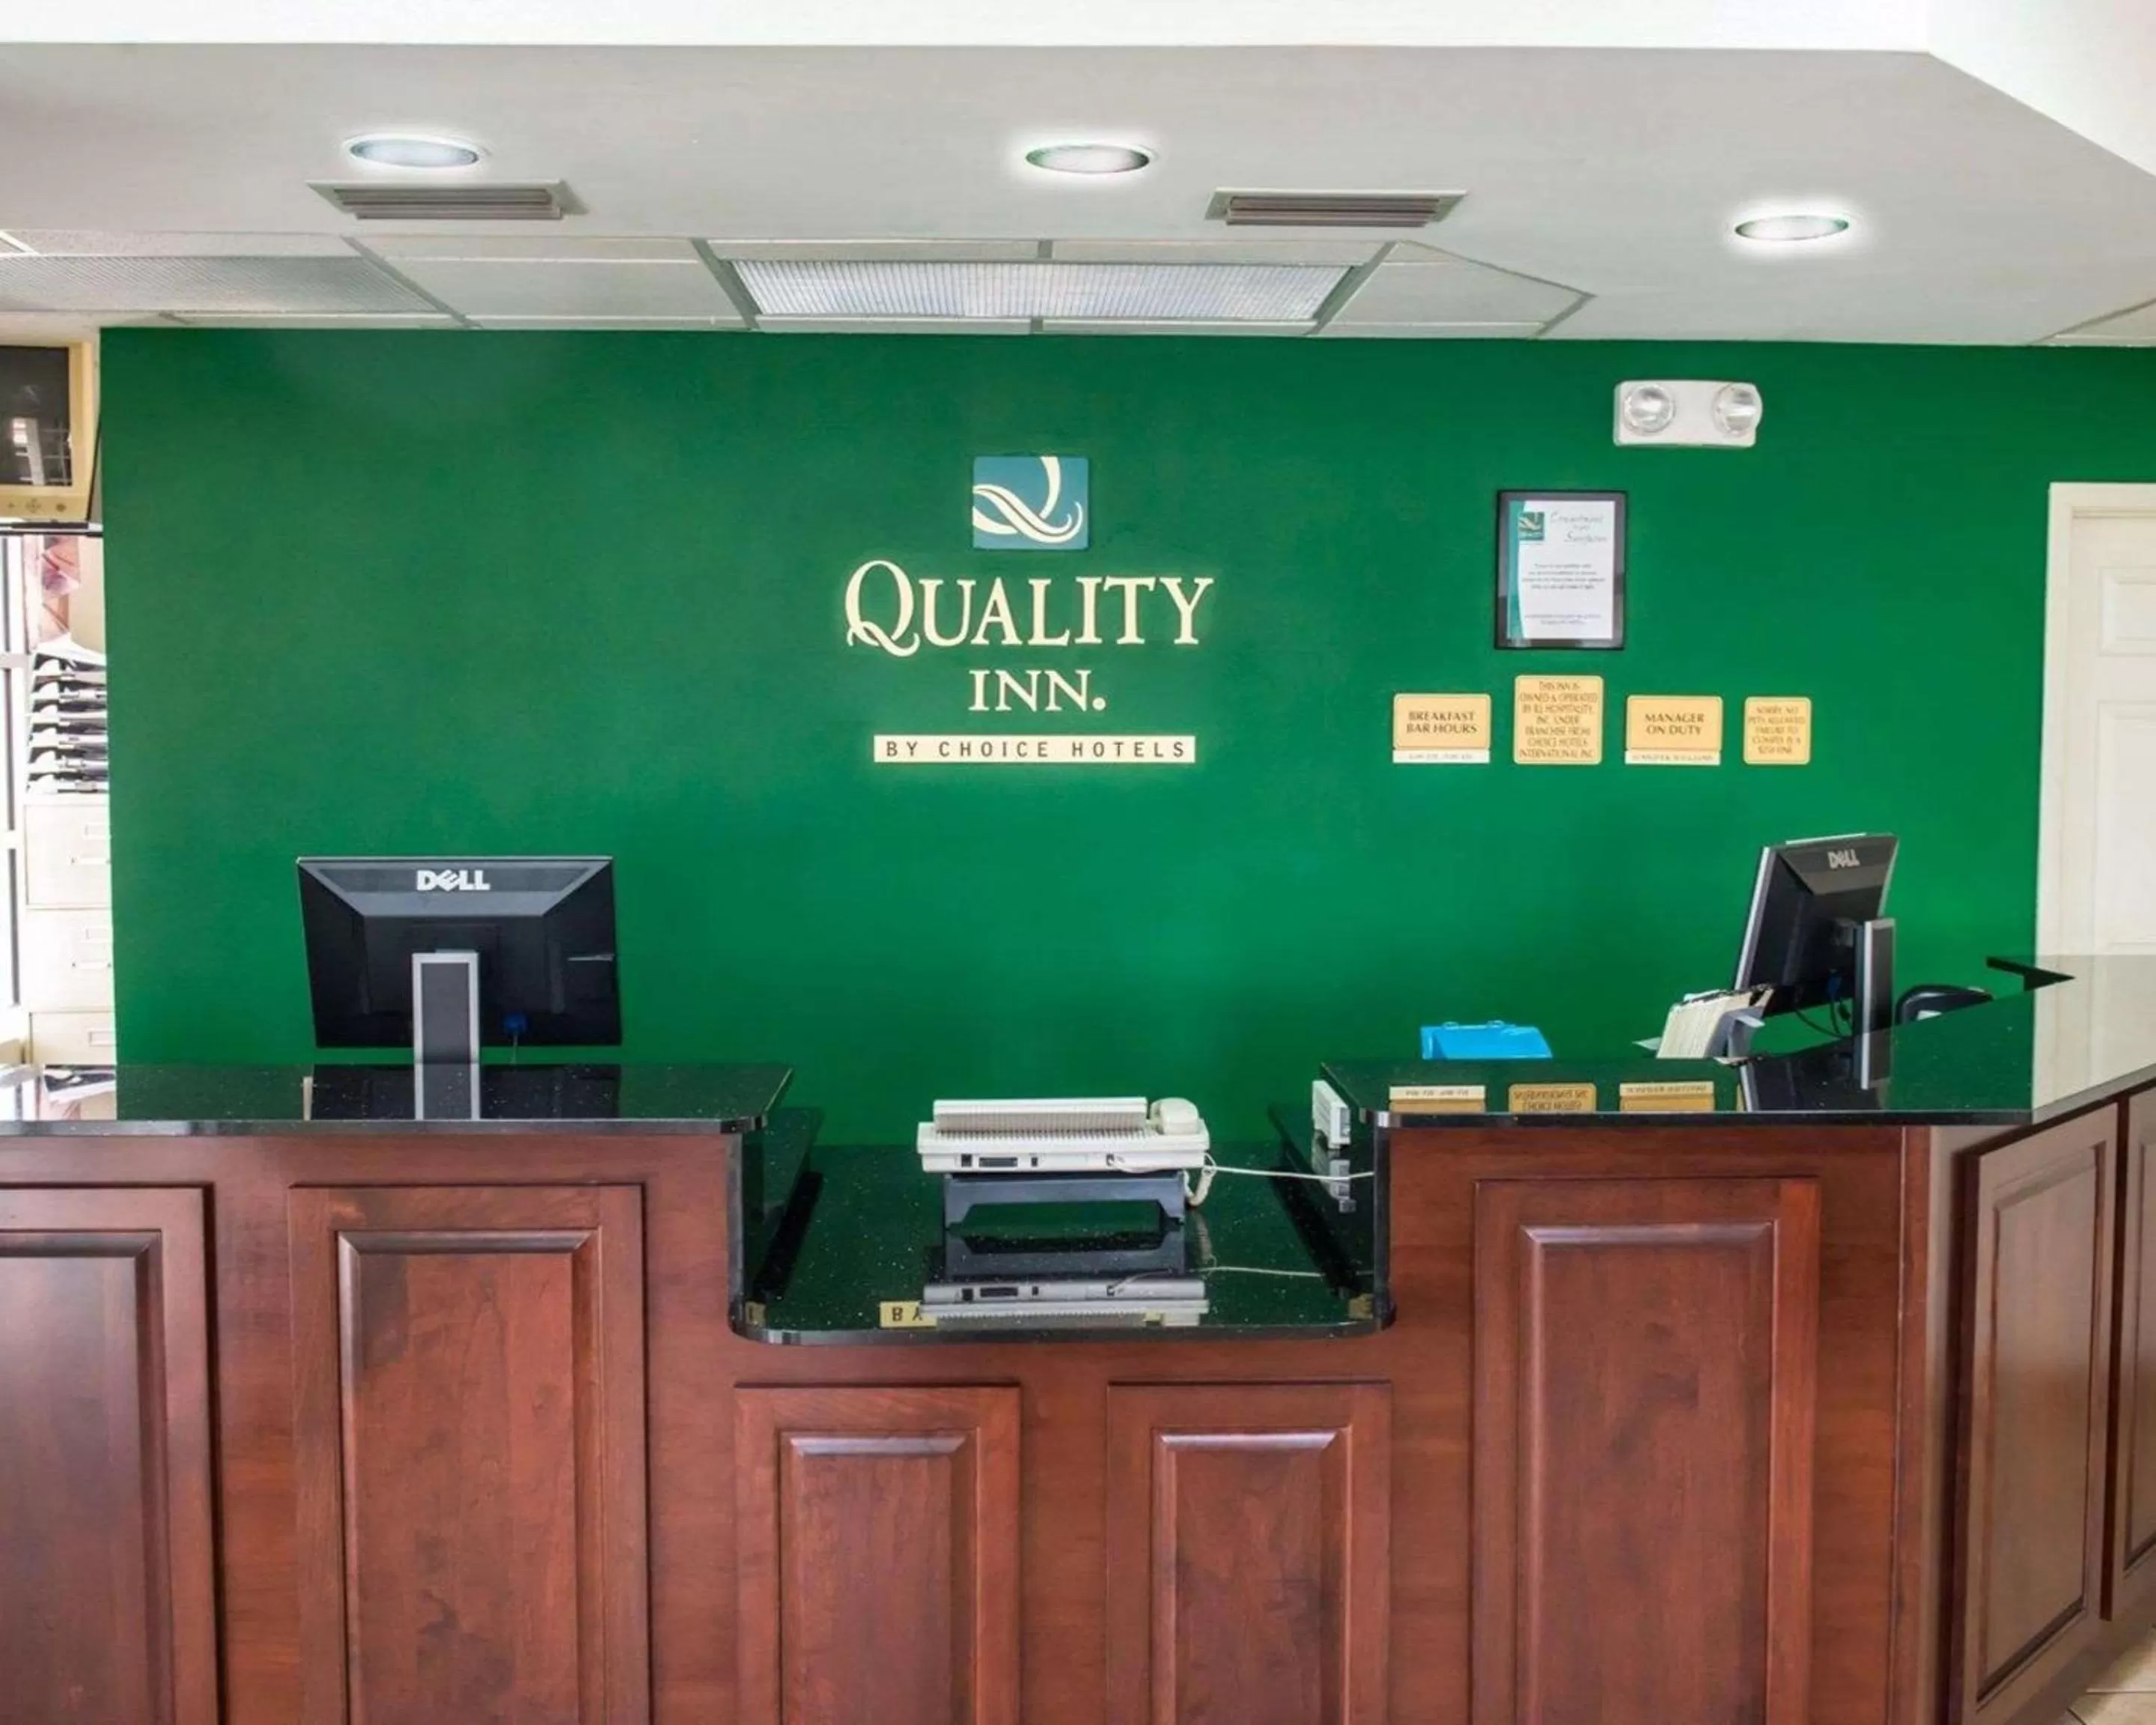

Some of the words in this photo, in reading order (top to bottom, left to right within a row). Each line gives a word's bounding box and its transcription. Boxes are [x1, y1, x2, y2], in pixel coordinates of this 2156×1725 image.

[845, 560, 1214, 657] QUALITY
[969, 670, 1106, 712] INN.
[1408, 711, 1475, 721] BREAKFAST
[1645, 713, 1705, 723] MANAGER
[1406, 722, 1431, 734] BAR
[1433, 722, 1478, 734] HOURS
[1646, 724, 1666, 735] ON
[1669, 724, 1703, 735] DUTY
[886, 741, 919, 758] BY
[939, 741, 1050, 758] CHOICE
[1072, 741, 1186, 758] HOTELS
[1827, 848, 1860, 868] DELL
[416, 868, 490, 892] DELL
